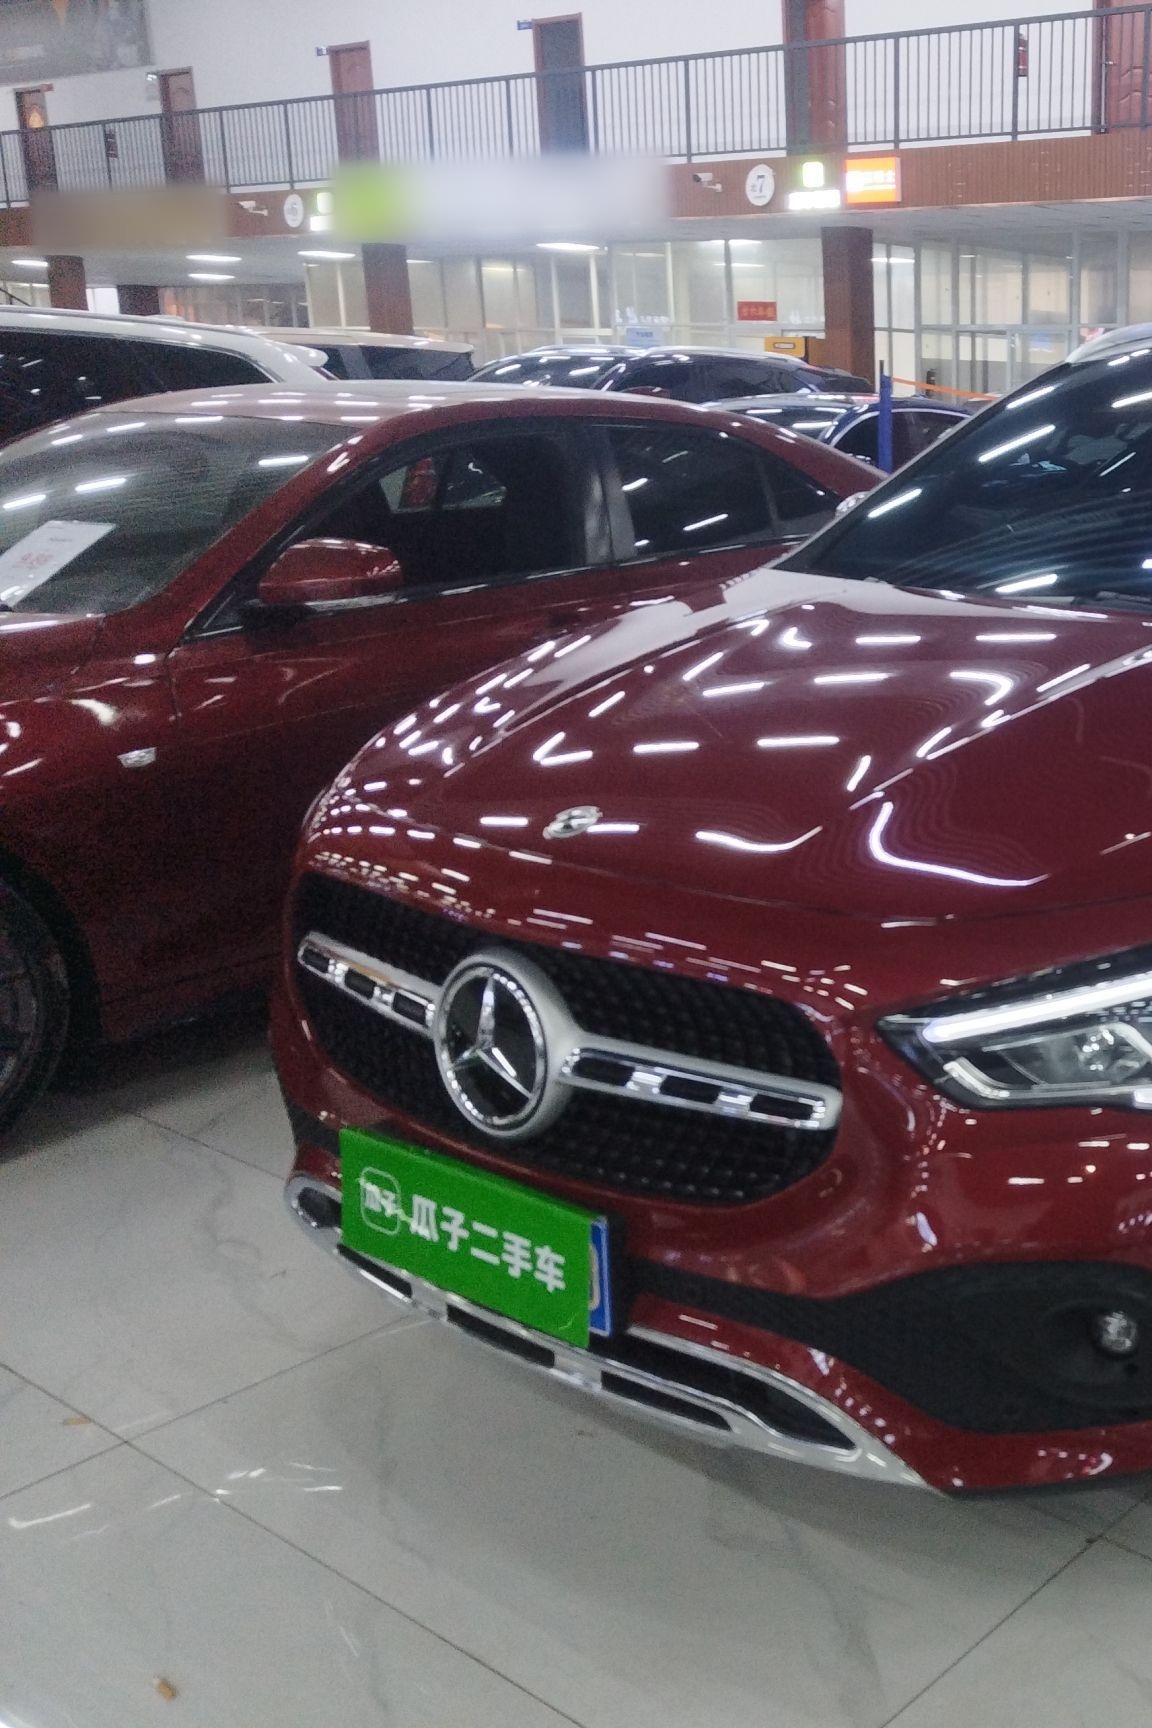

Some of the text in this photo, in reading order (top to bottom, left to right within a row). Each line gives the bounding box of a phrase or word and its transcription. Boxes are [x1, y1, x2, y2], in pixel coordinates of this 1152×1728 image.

[410, 1195, 566, 1293] 瓜子二手车
